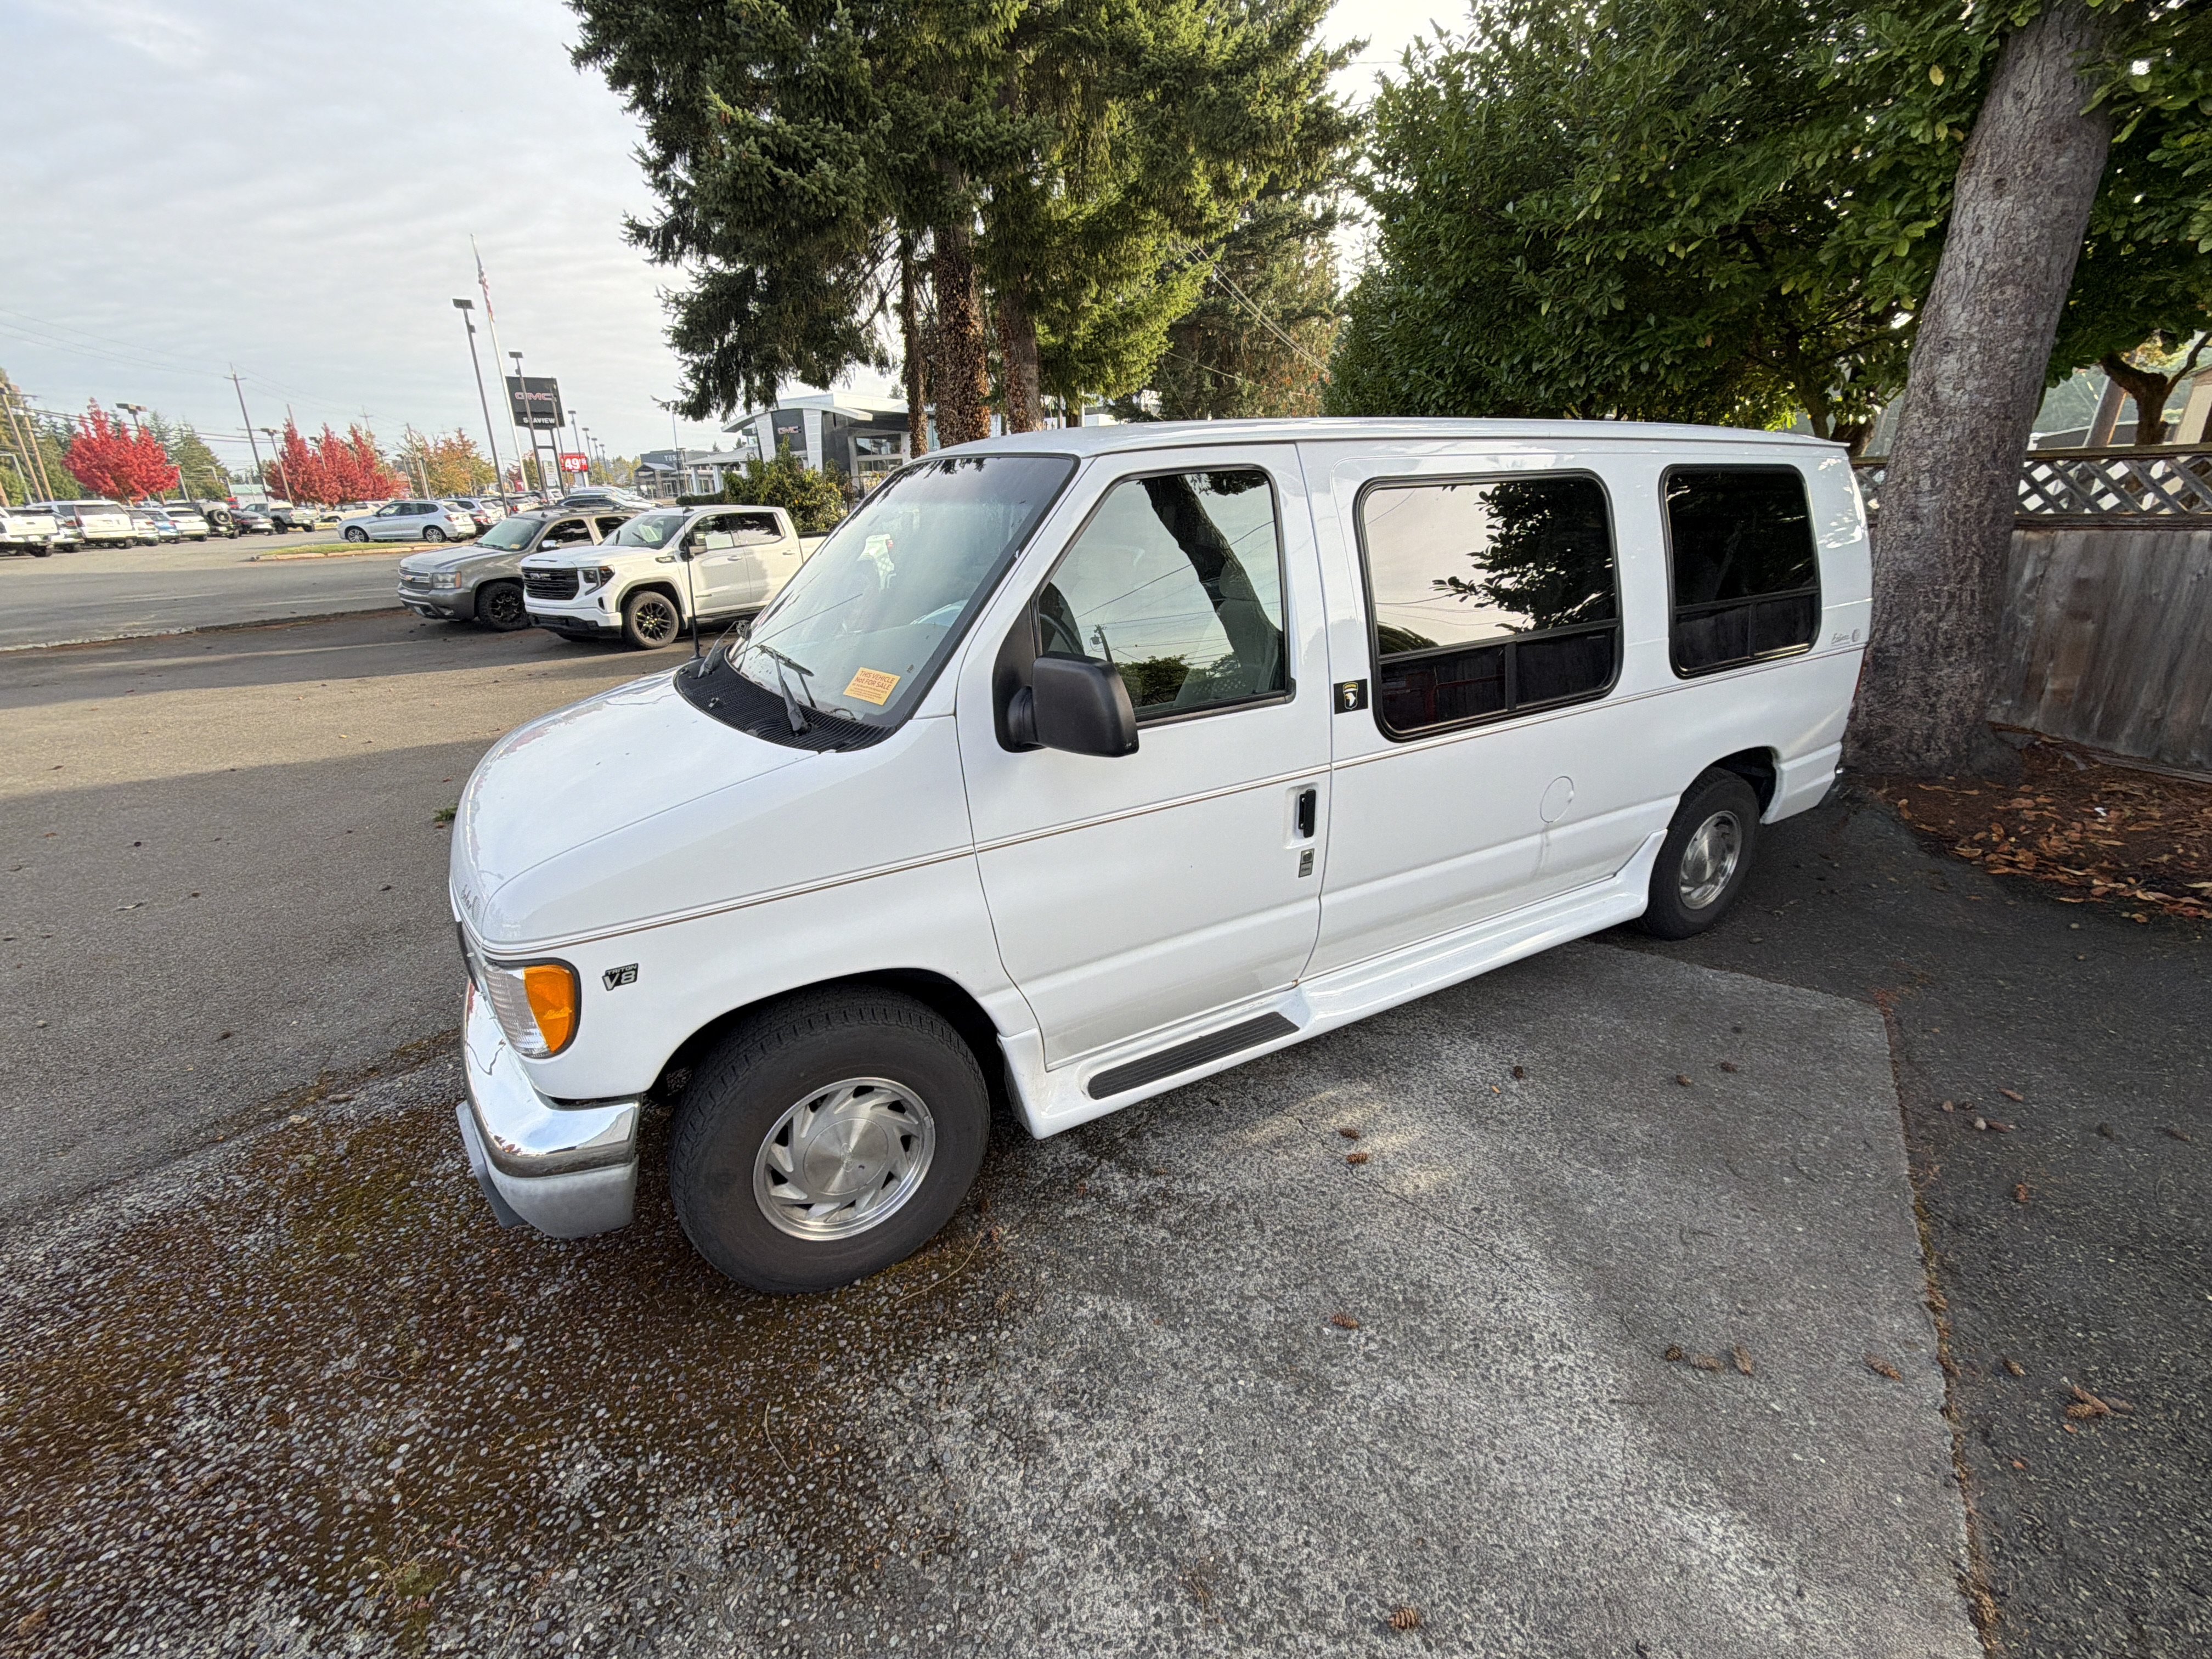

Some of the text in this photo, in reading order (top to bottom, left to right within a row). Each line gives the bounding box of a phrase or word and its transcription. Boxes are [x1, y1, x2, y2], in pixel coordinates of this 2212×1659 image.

[515, 392, 554, 401] GMC
[777, 426, 801, 435] GMC
[872, 673, 895, 684] VEHICLE
[876, 681, 891, 690] SALE
[606, 964, 637, 975] TRITON
[603, 970, 636, 990] V8
